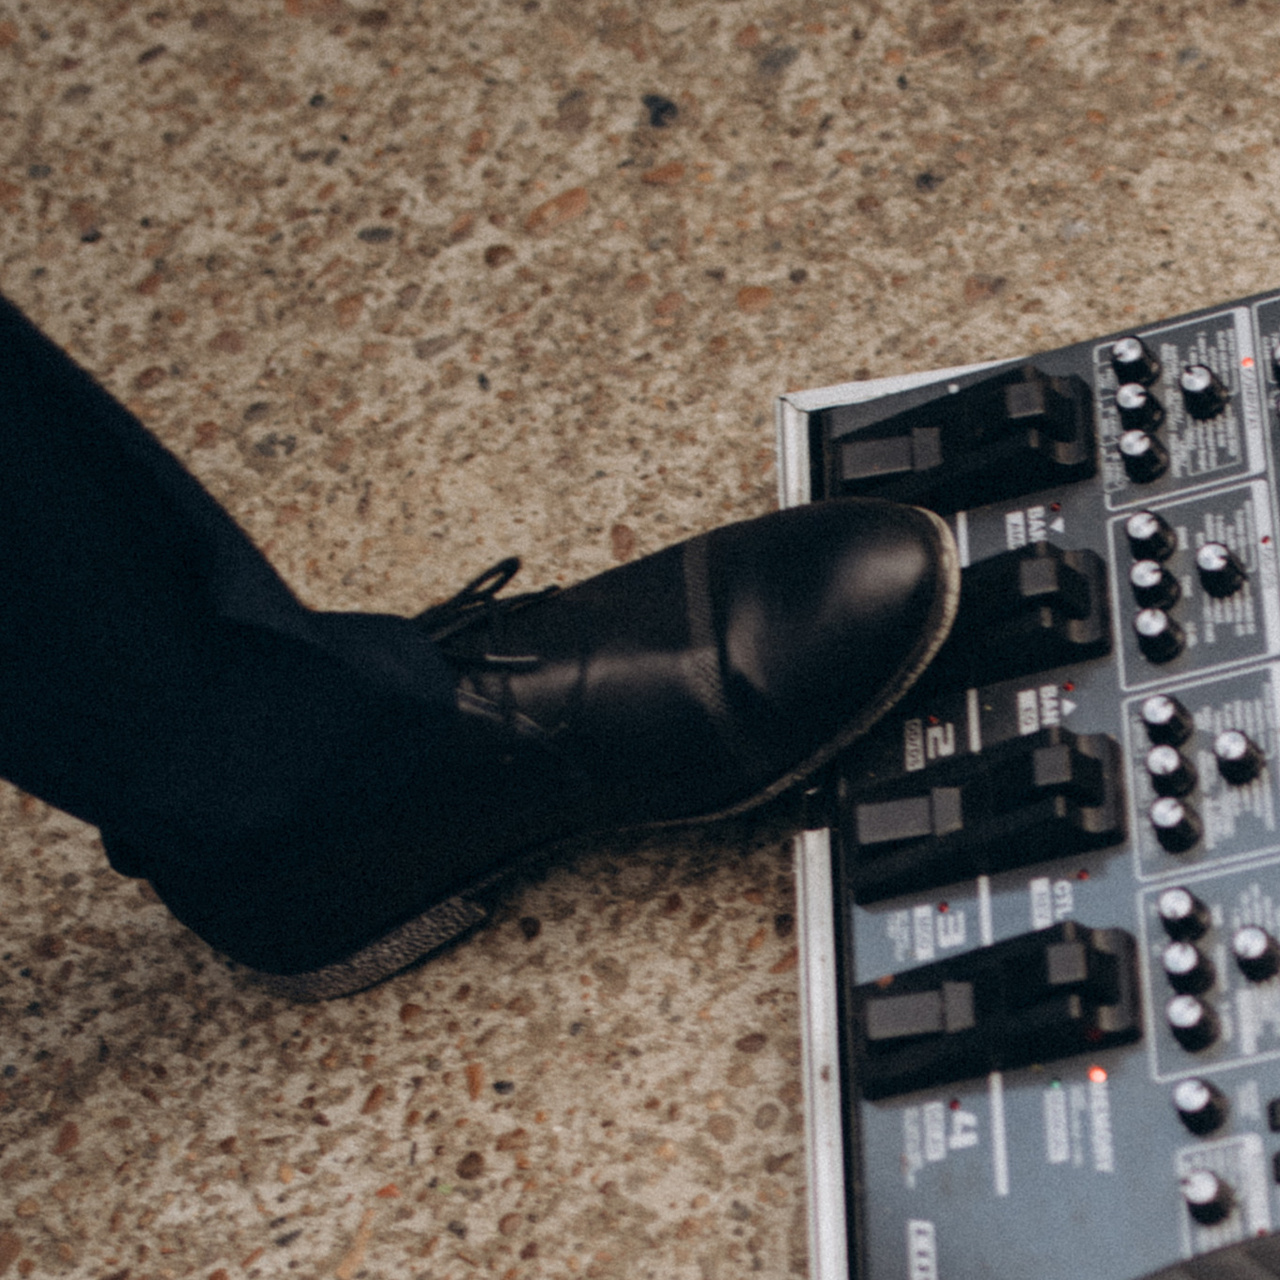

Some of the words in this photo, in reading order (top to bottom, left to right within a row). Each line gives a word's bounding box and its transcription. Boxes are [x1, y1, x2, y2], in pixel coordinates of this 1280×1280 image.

[1039, 684, 1060, 726] BAN
[926, 722, 956, 759] 2
[1053, 880, 1072, 919] CTL
[937, 909, 965, 948] 3
[949, 1112, 979, 1150] 4
